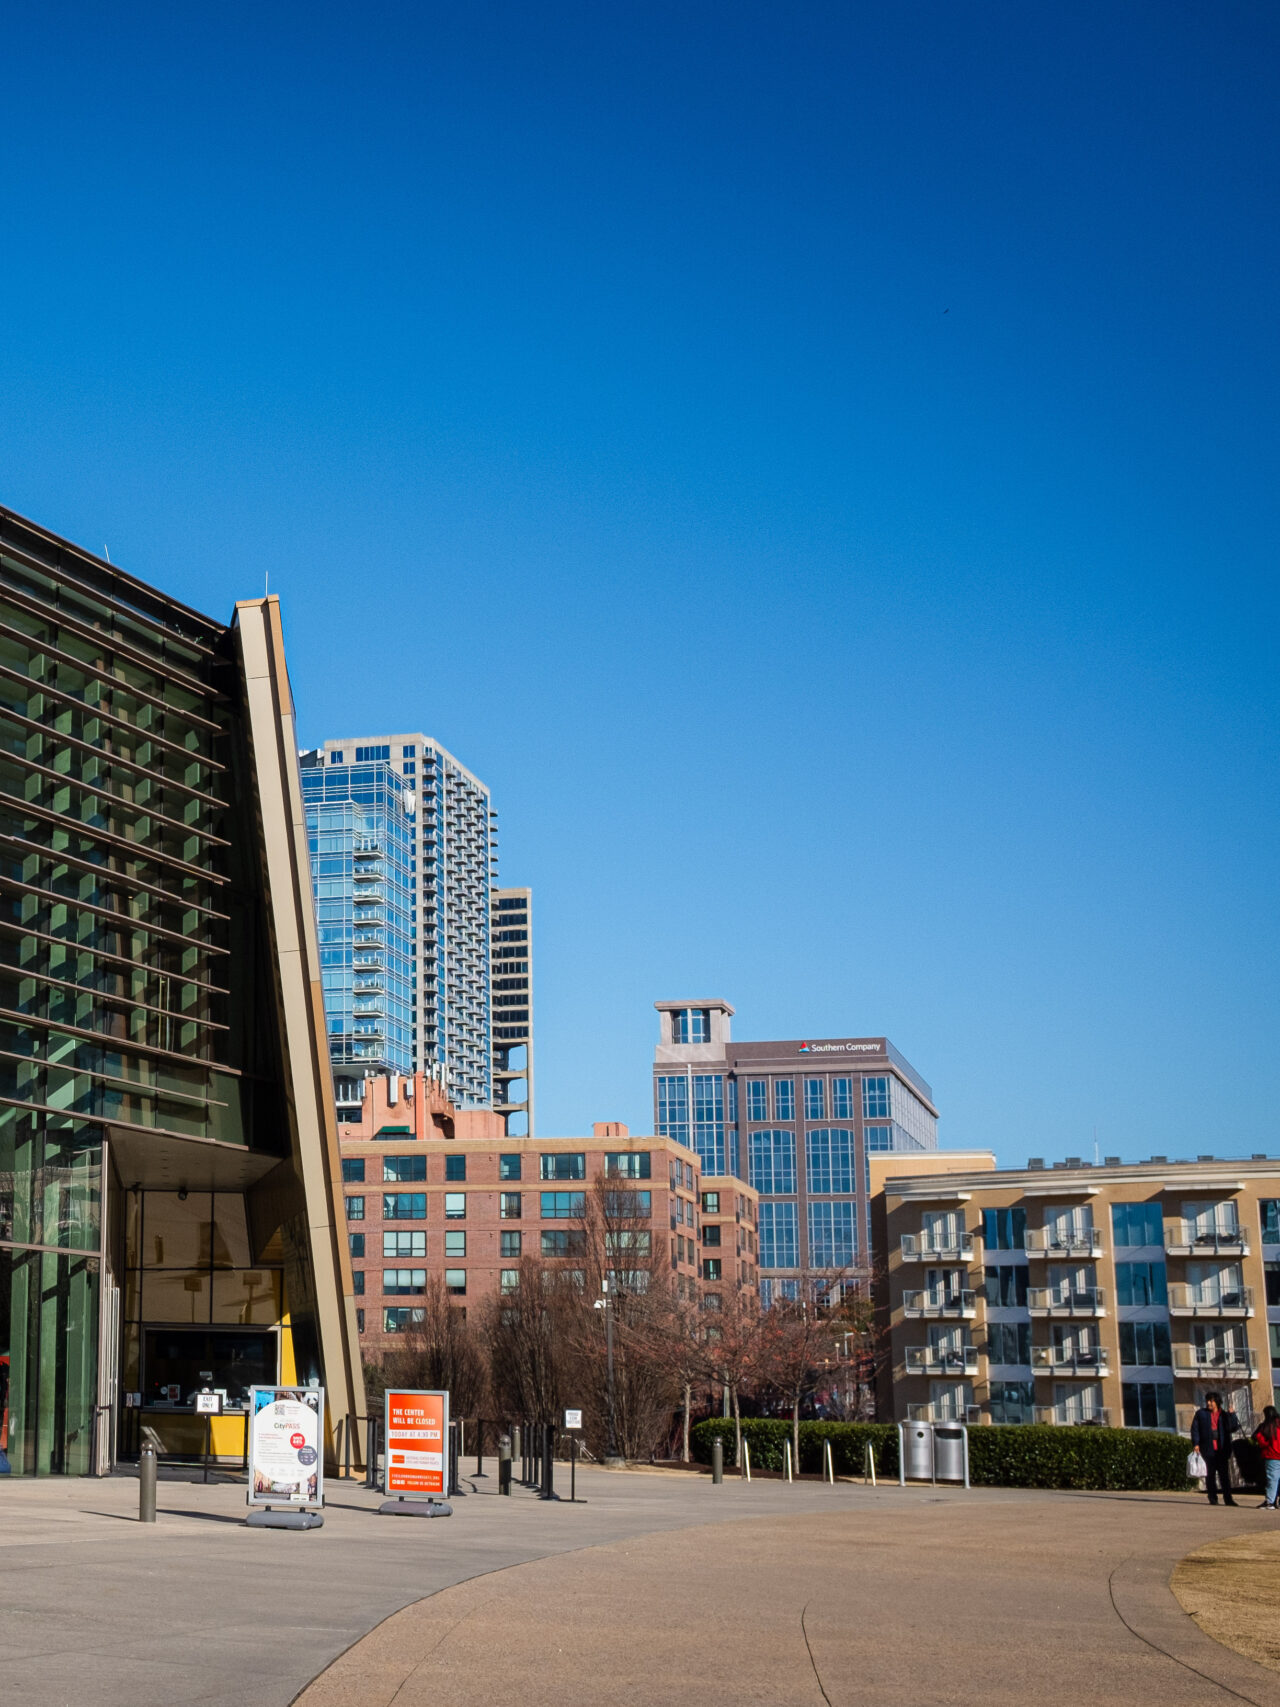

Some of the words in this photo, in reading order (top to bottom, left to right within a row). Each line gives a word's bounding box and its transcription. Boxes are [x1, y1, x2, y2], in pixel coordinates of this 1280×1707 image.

[811, 1043, 845, 1053] Southern
[846, 1042, 880, 1052] Company
[392, 1417, 406, 1425] WILL
[415, 1417, 436, 1425] CLOSED
